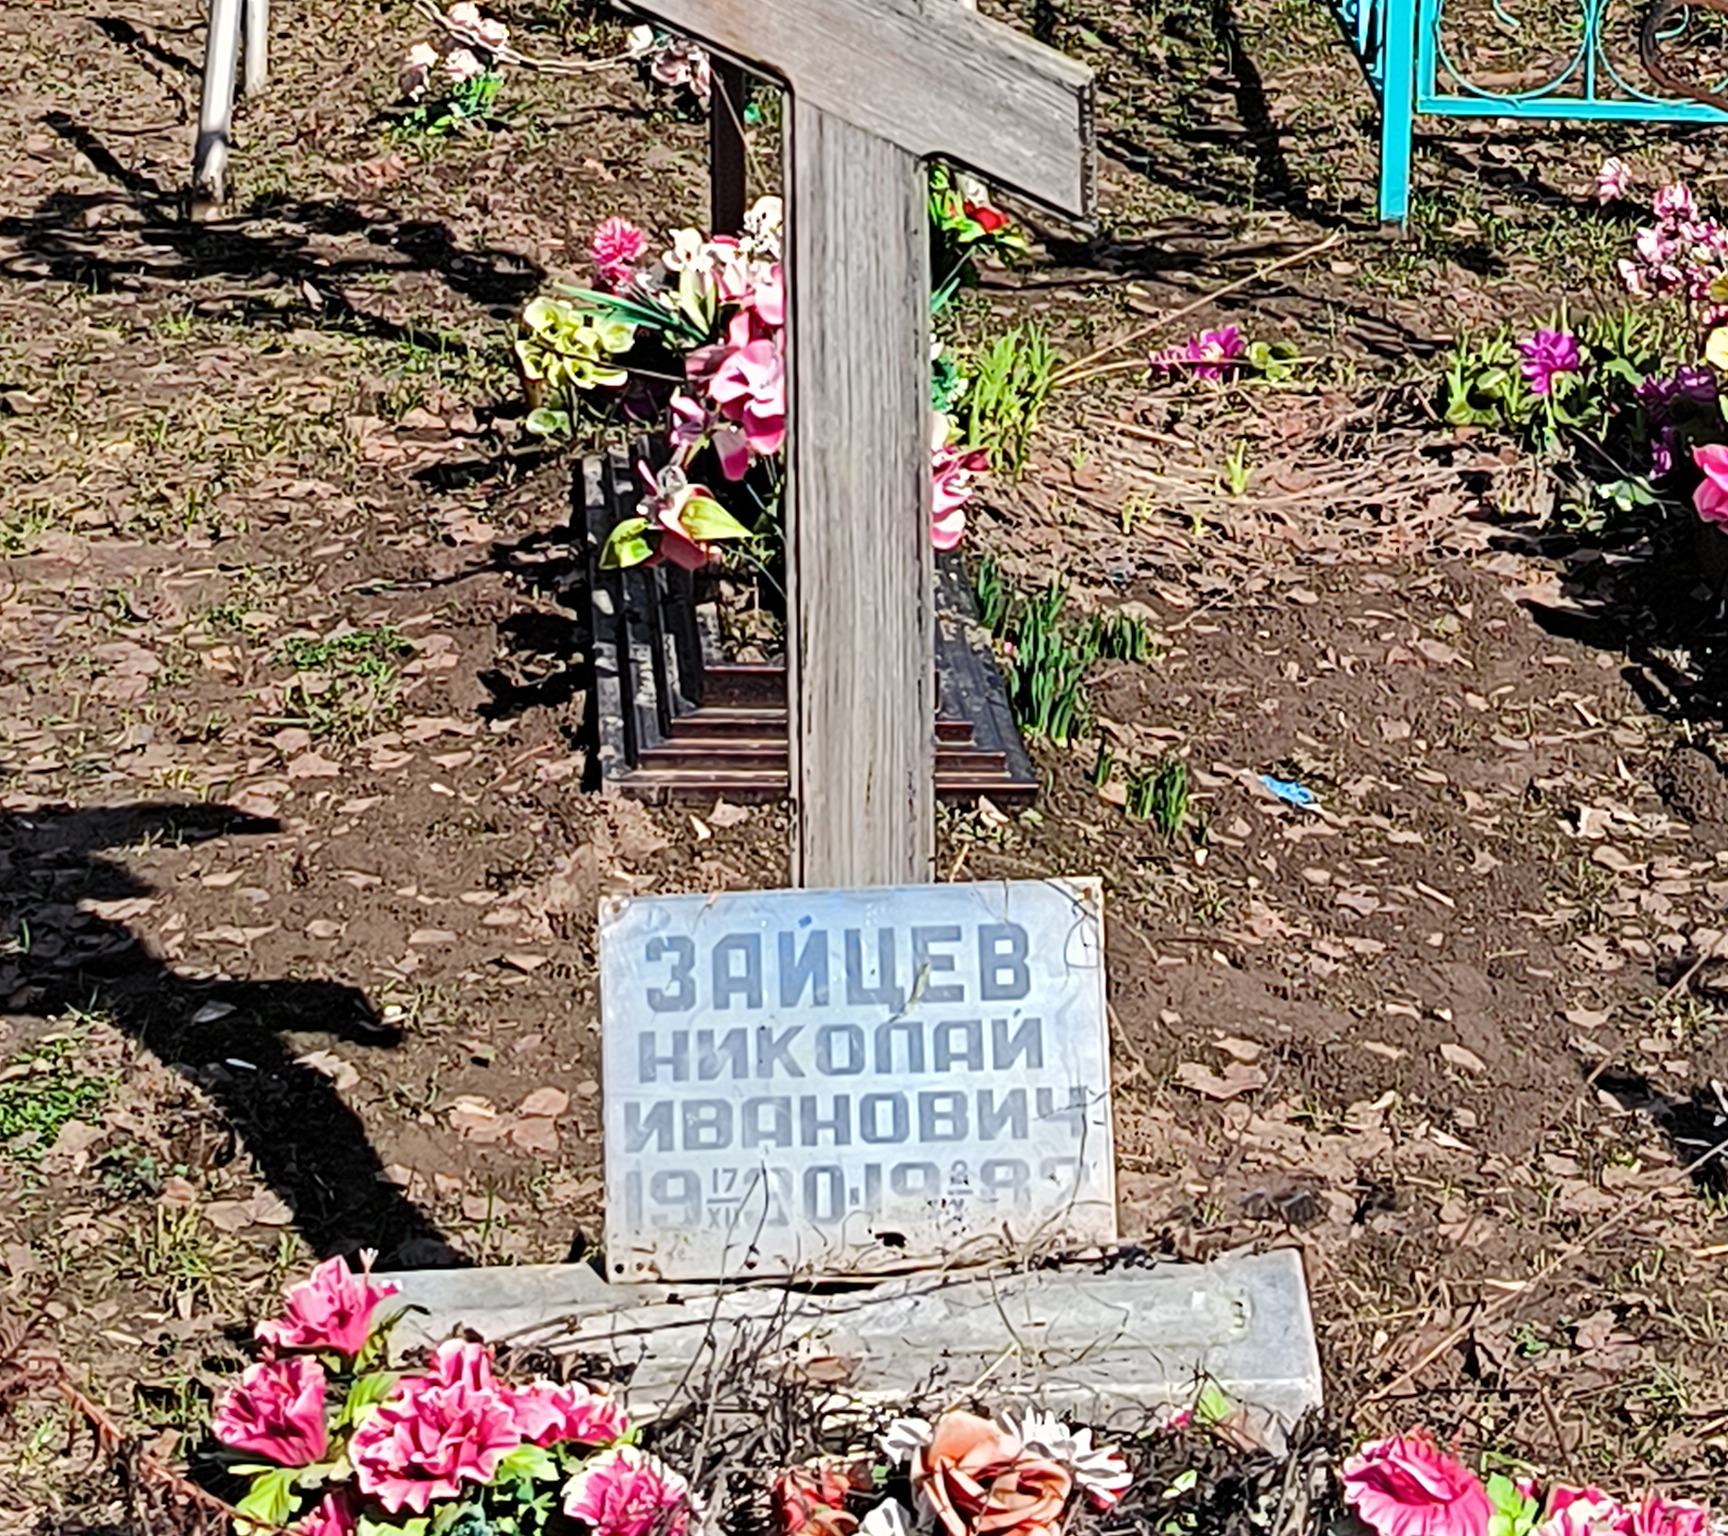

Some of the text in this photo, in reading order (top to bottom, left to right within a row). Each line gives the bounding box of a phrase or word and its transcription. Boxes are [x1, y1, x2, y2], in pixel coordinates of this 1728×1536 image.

[645, 915, 1032, 1015] ЗАЙЦЕВ
[638, 1008, 1044, 1084] НИКОЛАЙ
[623, 1085, 1088, 1154] ИВАНОВИЧ
